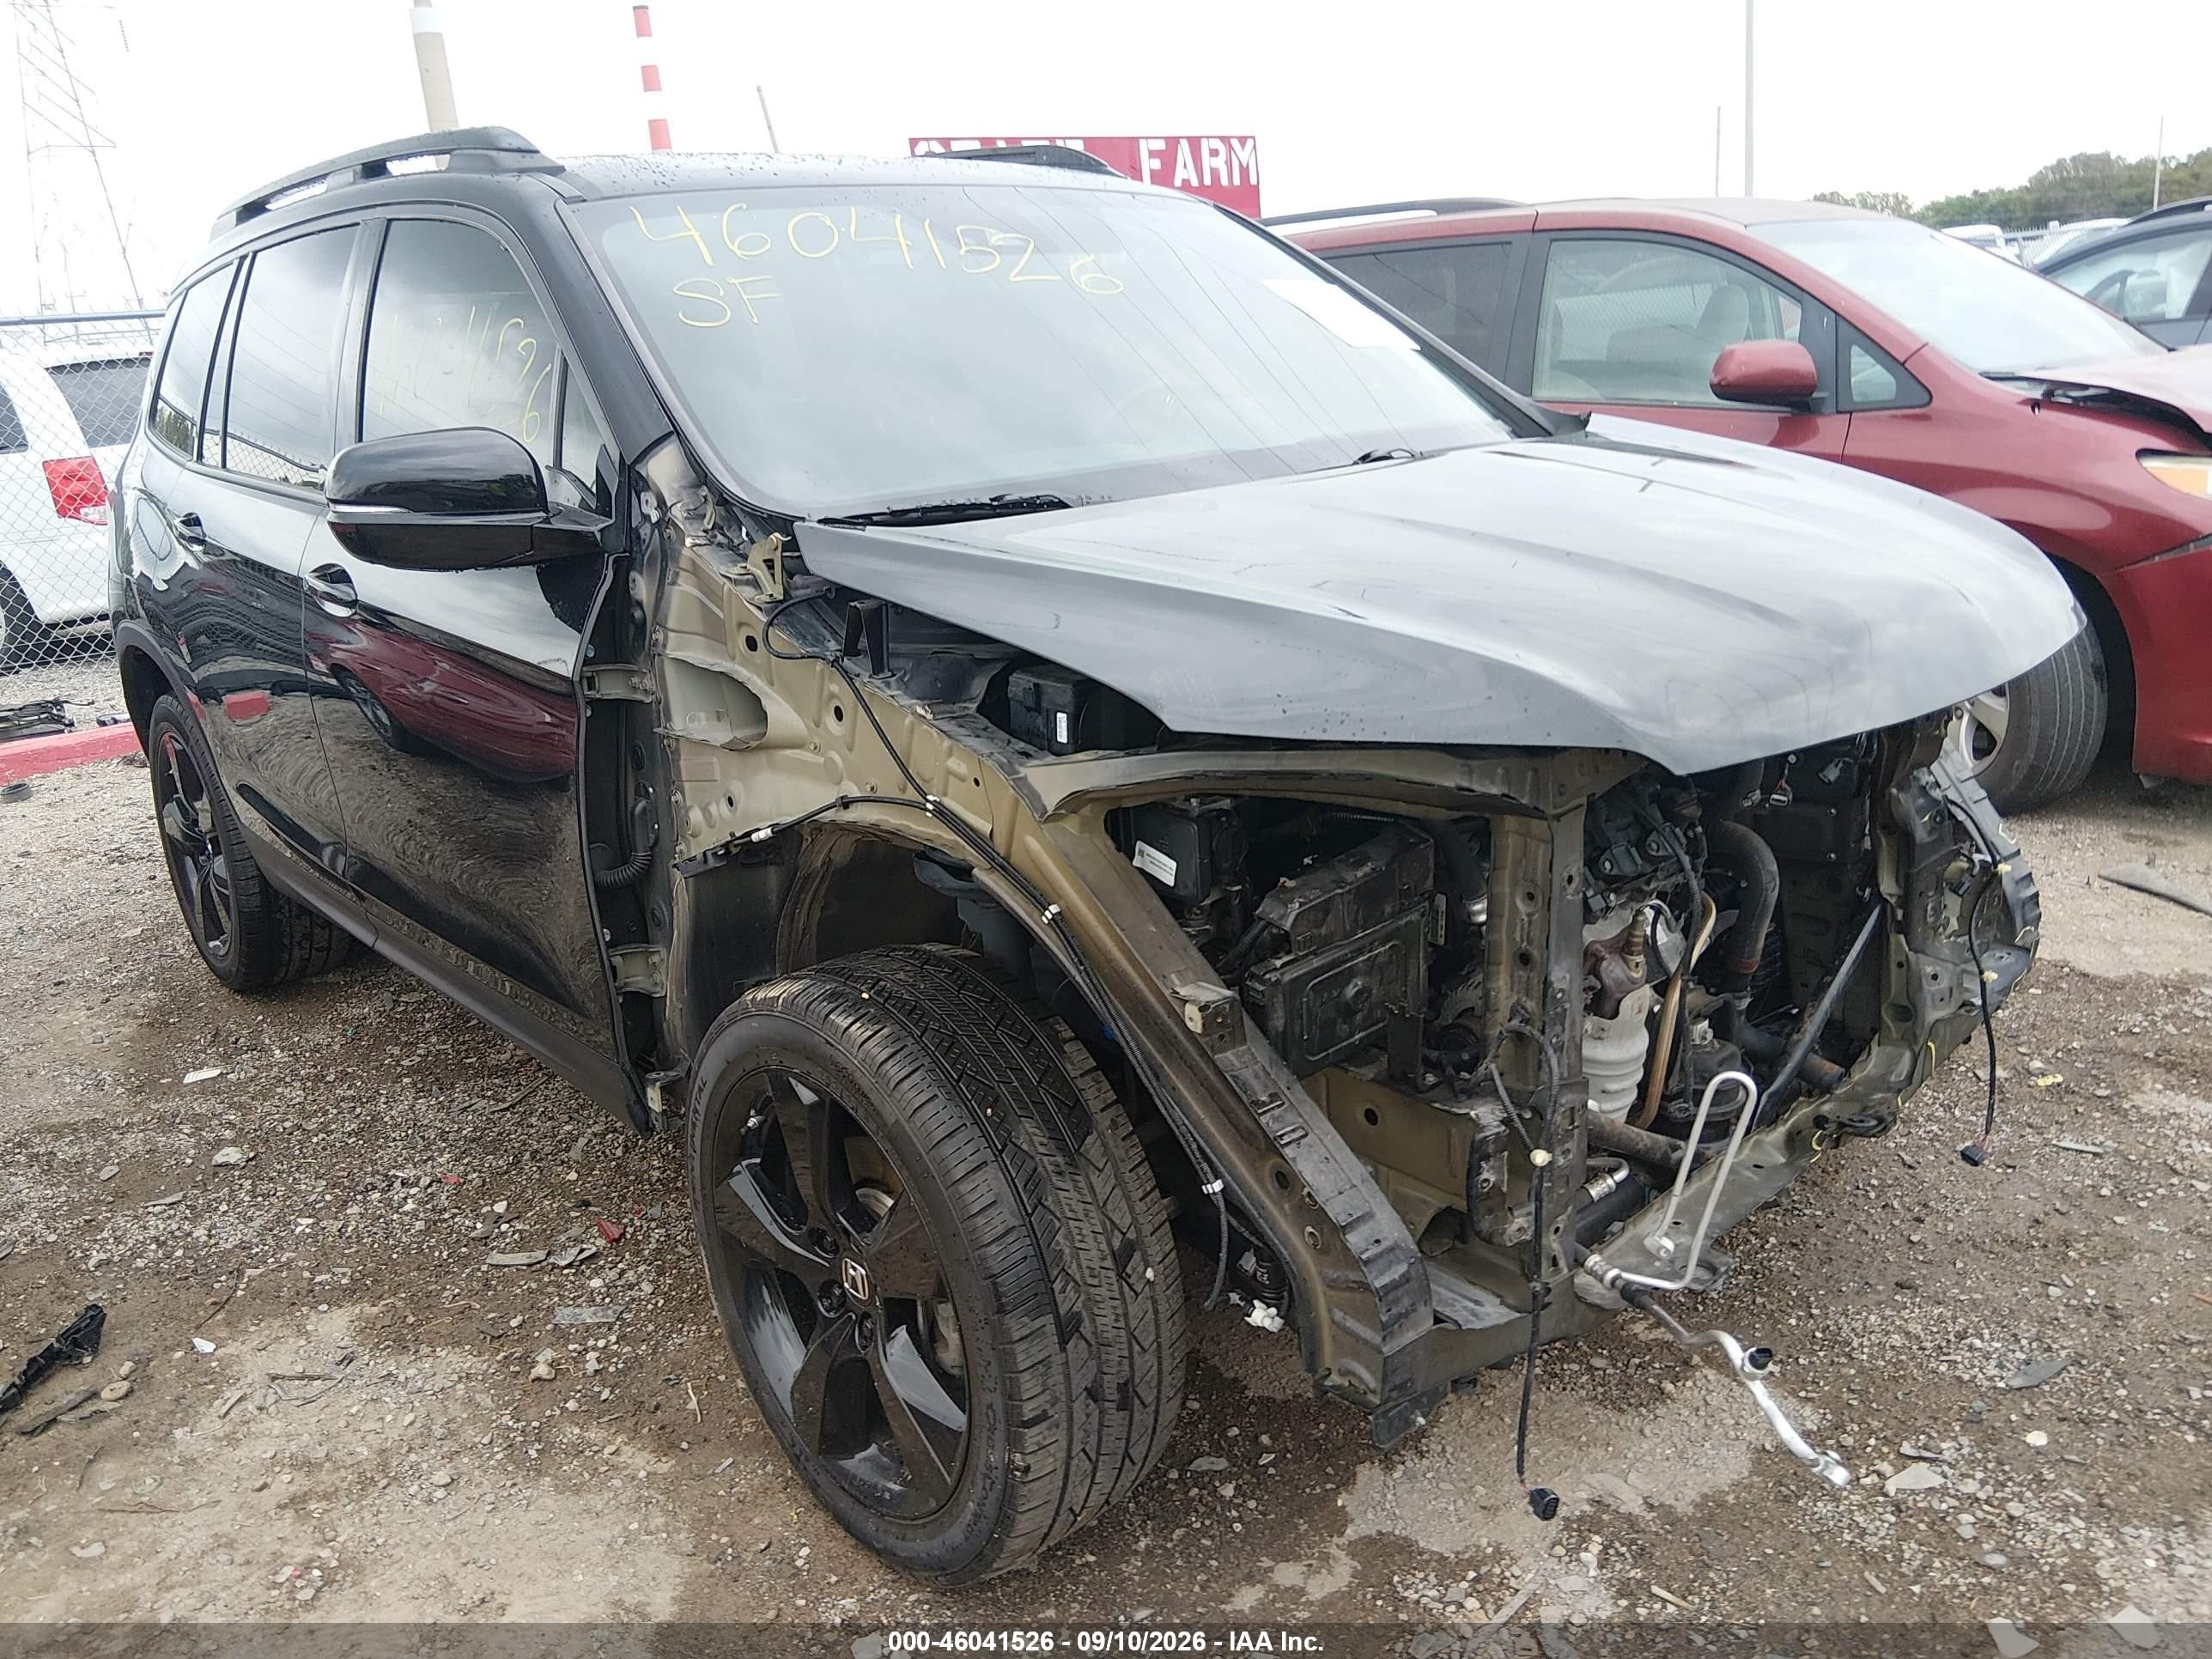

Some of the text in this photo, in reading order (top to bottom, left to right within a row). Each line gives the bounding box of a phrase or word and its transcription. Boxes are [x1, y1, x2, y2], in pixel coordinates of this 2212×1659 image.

[1139, 137, 1259, 187] FARM
[629, 204, 1124, 295] 46041526
[672, 275, 782, 328] SF
